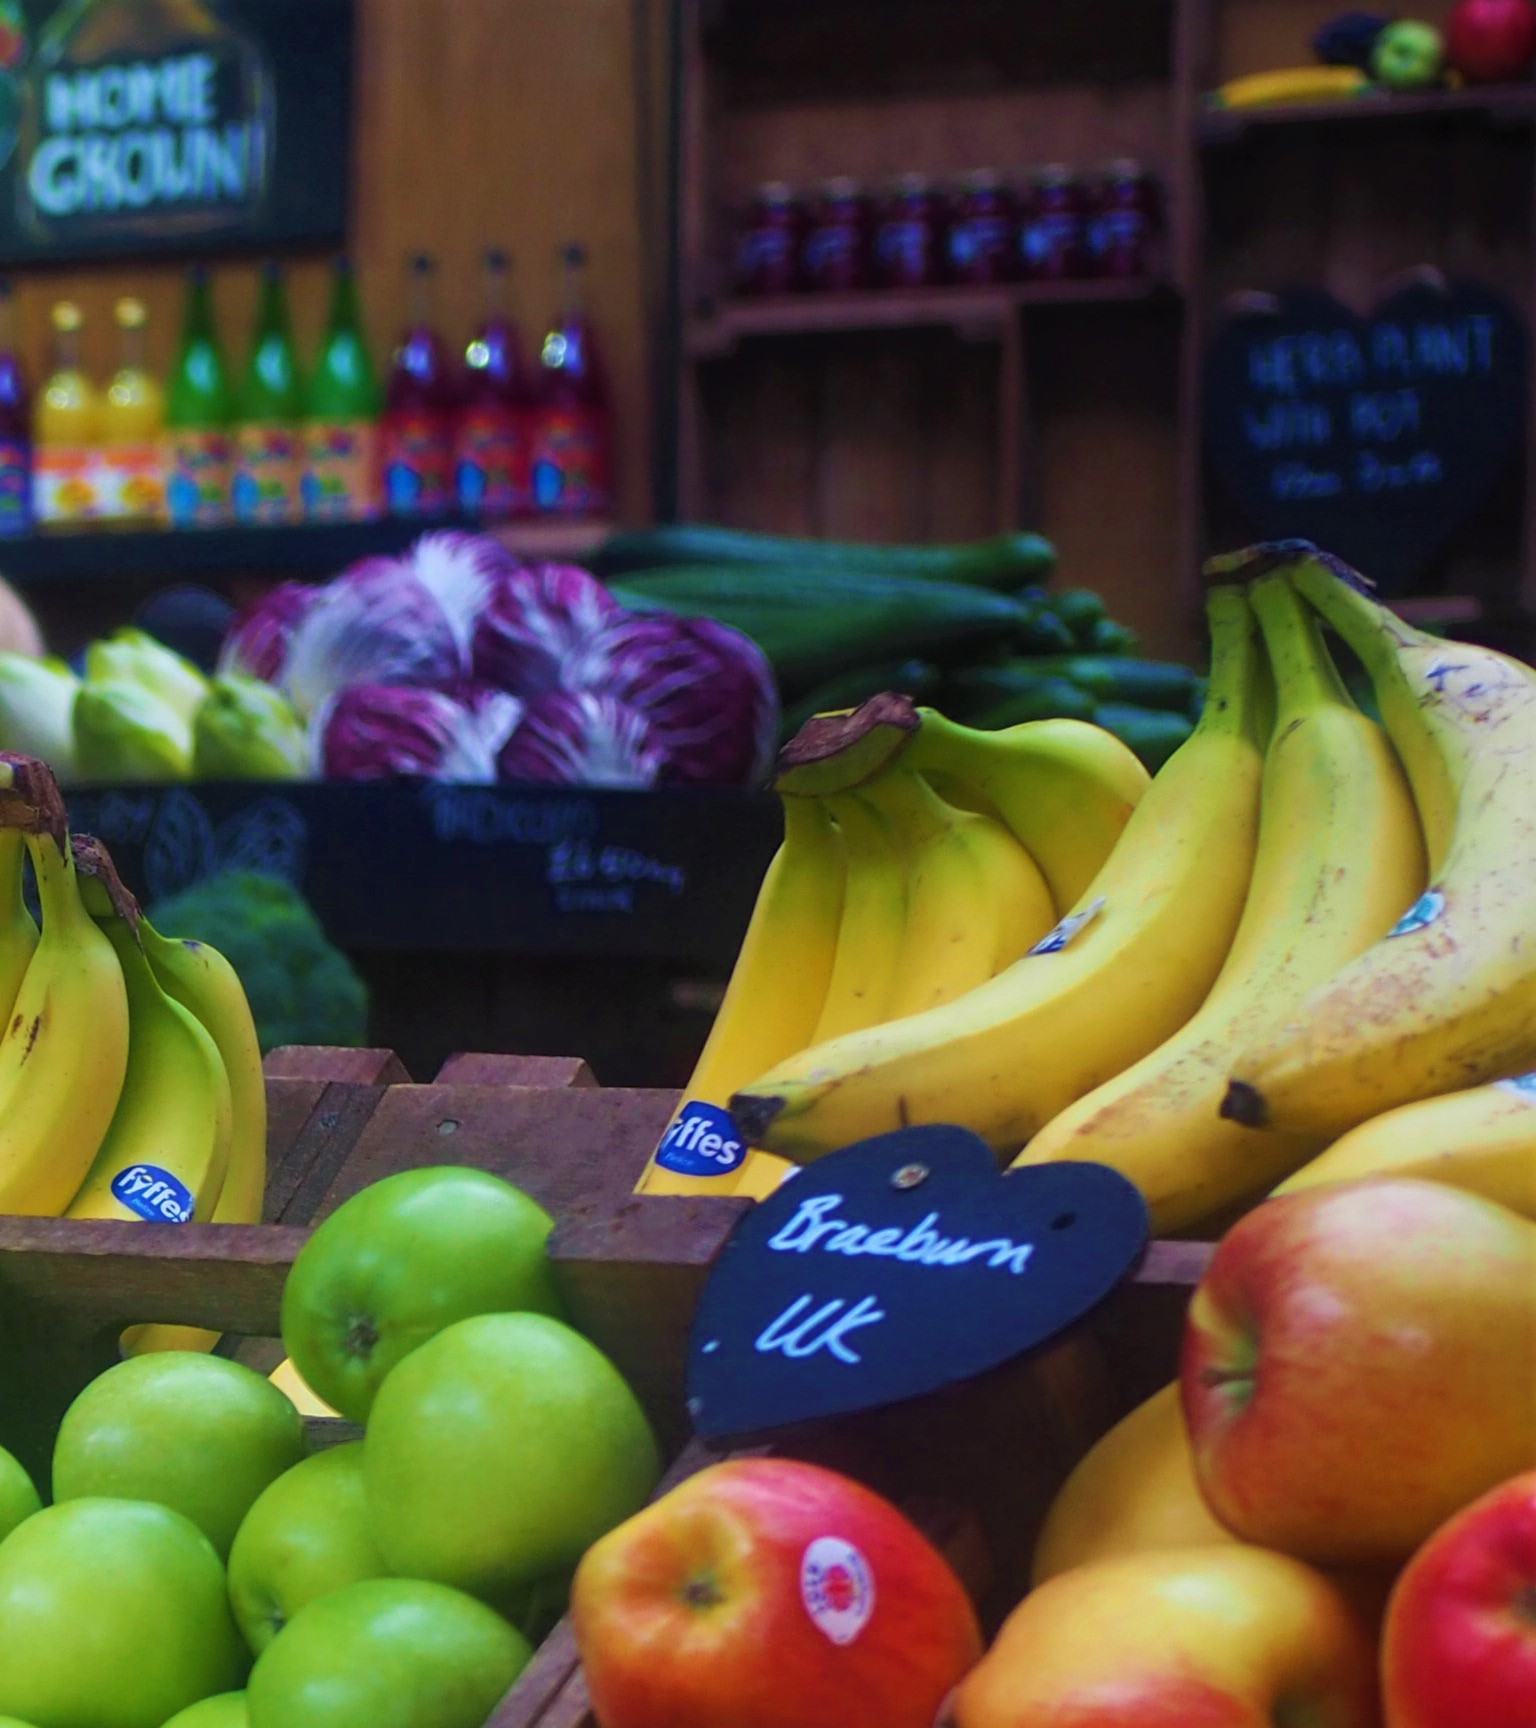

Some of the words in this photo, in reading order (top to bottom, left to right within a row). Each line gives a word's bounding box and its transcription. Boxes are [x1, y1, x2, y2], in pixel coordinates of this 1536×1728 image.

[45, 52, 217, 131] HOME
[768, 1193, 1035, 1275] Braeburn
[754, 1294, 886, 1364] UK
